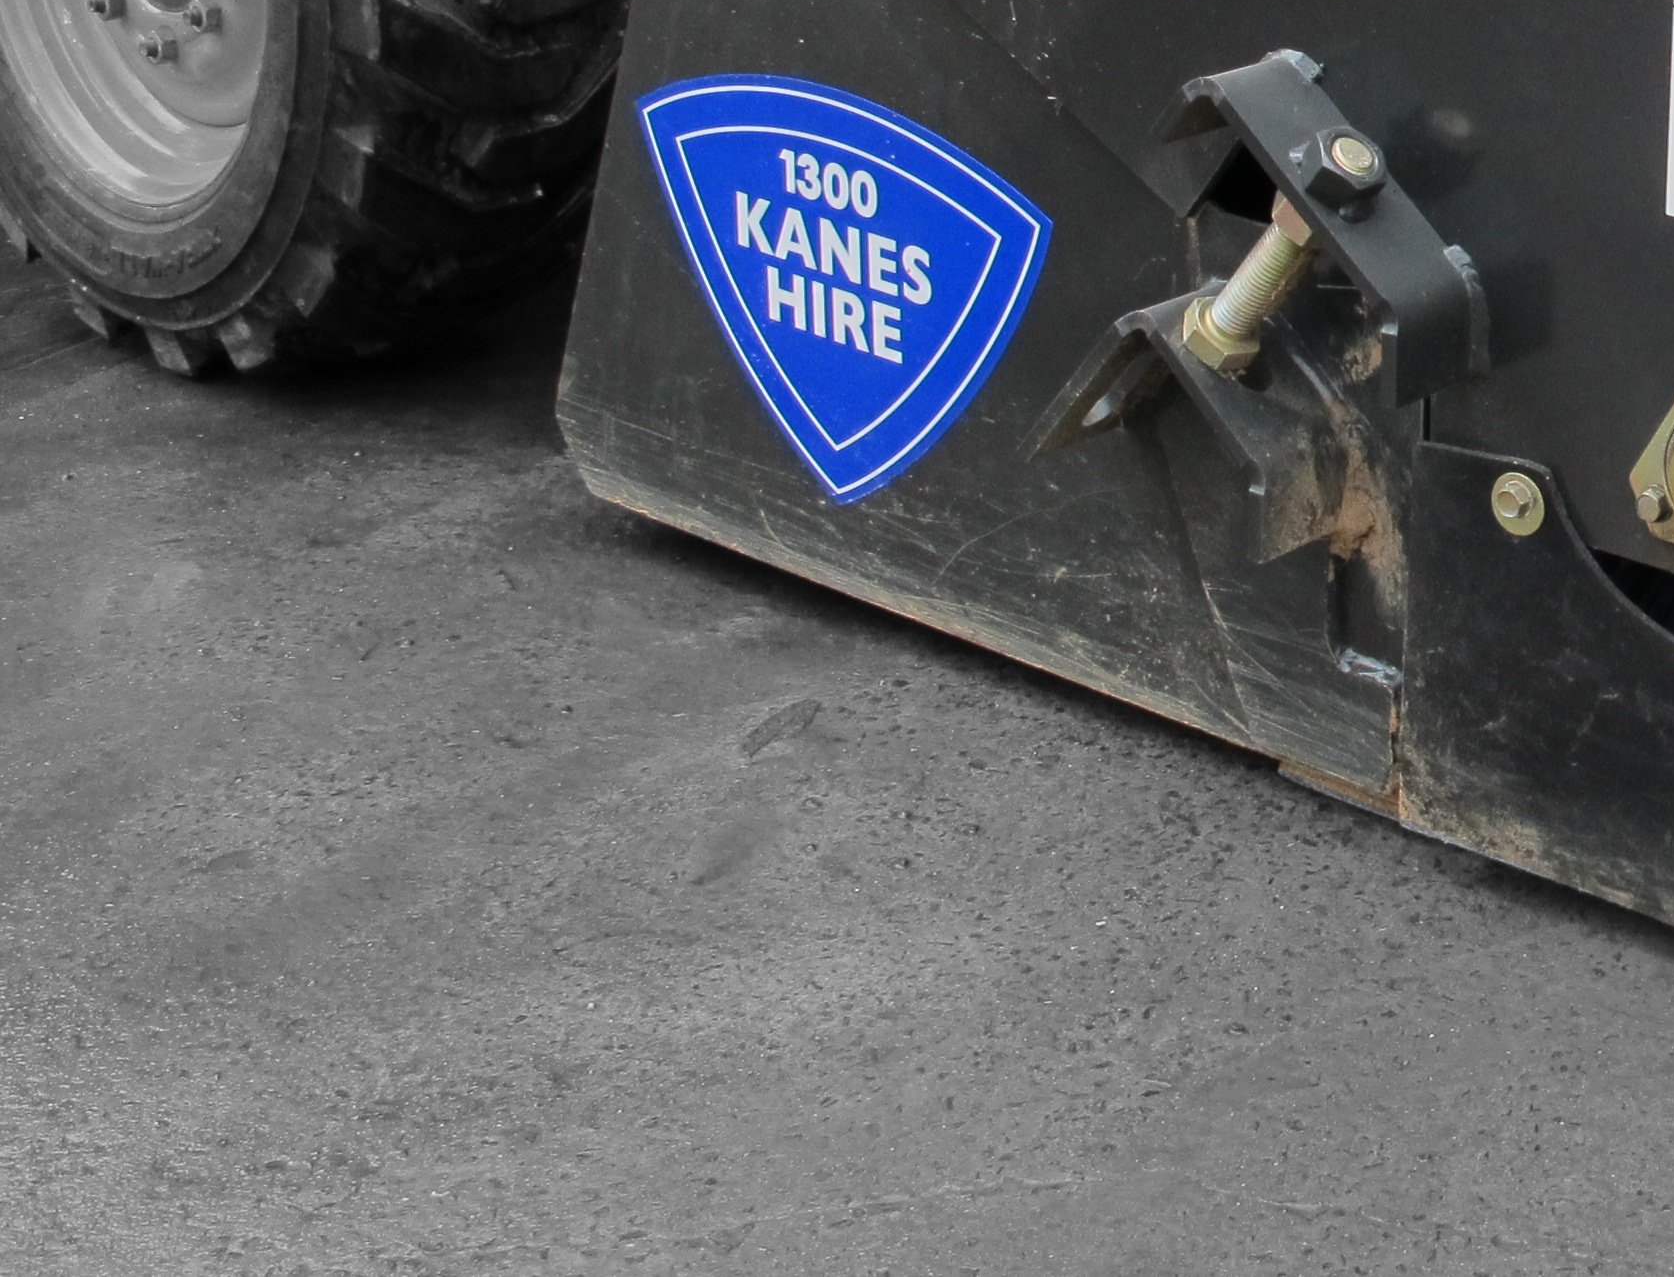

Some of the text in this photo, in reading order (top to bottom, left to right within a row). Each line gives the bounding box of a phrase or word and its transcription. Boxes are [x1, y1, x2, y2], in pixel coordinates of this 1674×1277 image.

[779, 148, 878, 219] 1300
[735, 190, 933, 305] KANES
[766, 265, 903, 364] HIRE
